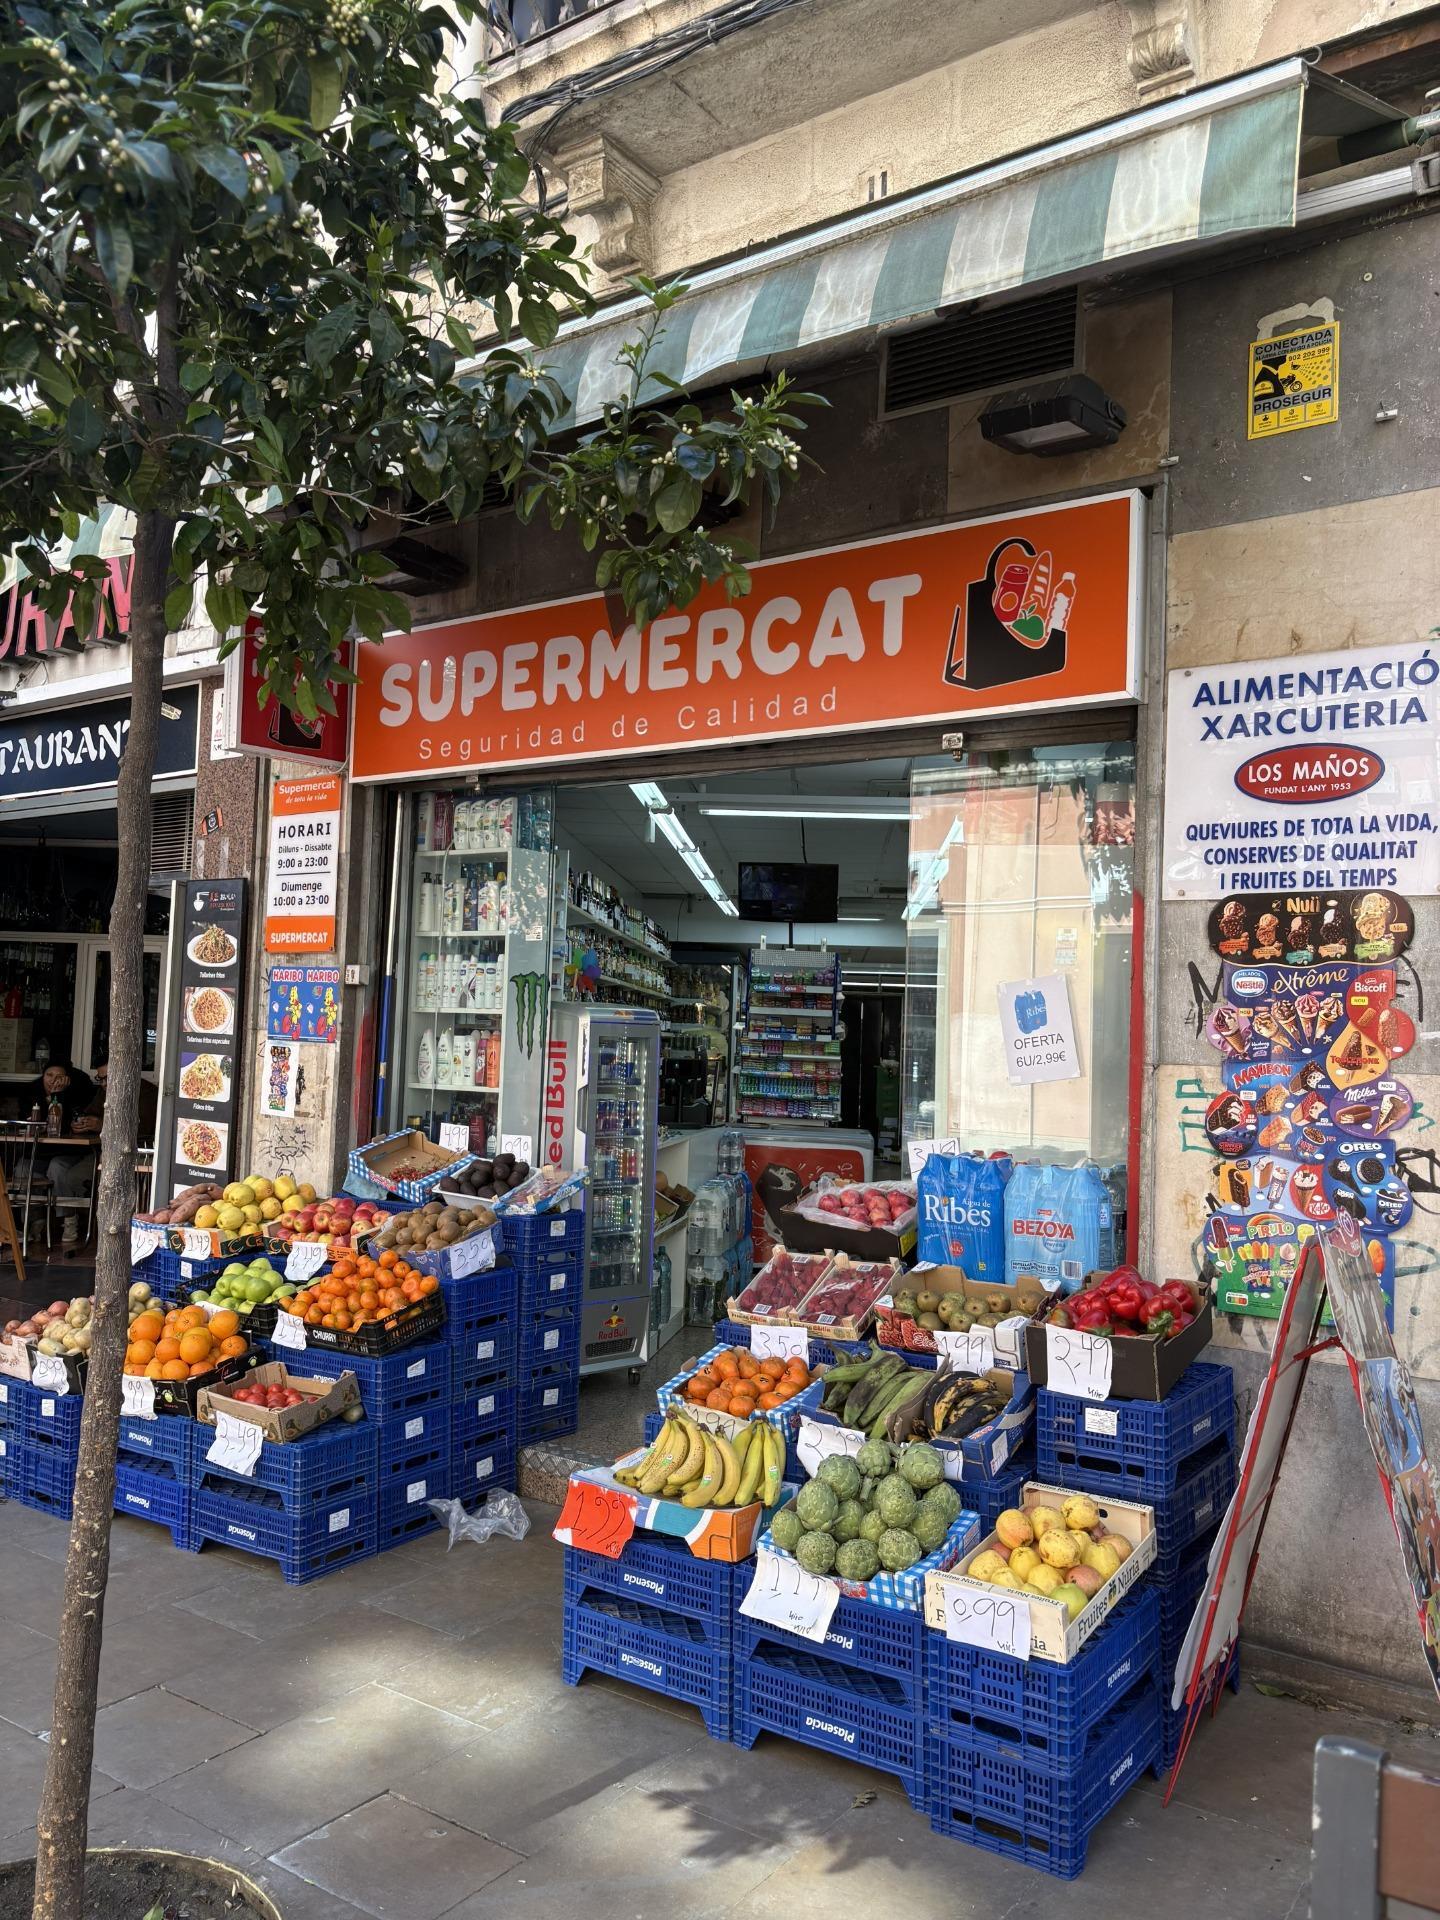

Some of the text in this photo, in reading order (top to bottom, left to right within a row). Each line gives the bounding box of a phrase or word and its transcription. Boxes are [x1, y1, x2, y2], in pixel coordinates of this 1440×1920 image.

[1255, 329, 1332, 356] CONECTADA
[1289, 354, 1301, 362] 902
[1303, 350, 1316, 360] 202
[1317, 346, 1331, 356] 999
[1254, 388, 1332, 414] PROSEGUR
[379, 572, 923, 728] SUPERMERCAT
[1192, 649, 1439, 708] ALIMENTACIÓ
[419, 686, 837, 761] Seguridad de Calidad
[1200, 696, 1428, 741] XARCUTERIA
[0, 719, 131, 775] TAURAN
[1247, 753, 1370, 784] LOS MAÑOS
[279, 779, 337, 795] Supermercat
[1264, 782, 1352, 795] FUNDAT L'ANY 1953
[278, 822, 332, 839] HORARI
[1186, 812, 1439, 842] QUEVIURES DE TOTA LA VIDA,
[278, 843, 332, 854] Dilluns Dissabte
[1203, 840, 1418, 866] CONSERVES DE QUALITAT
[277, 859, 296, 869] 9:00
[304, 856, 328, 867] 23:00
[281, 881, 322, 893] Diumenge
[1219, 867, 1398, 890] I FRUITES DEL TEMPS
[273, 896, 296, 906] 10:00
[270, 932, 328, 943] SUPERMERCAT
[272, 969, 340, 983] HARIBO HARIBO
[1354, 981, 1387, 993] Biscoff
[1014, 1033, 1065, 1050] OFERTA
[1016, 1051, 1067, 1068] 6U/2,99€
[1232, 1062, 1292, 1090] MAXIBON
[545, 1040, 567, 1168] ed Bull
[1343, 1087, 1378, 1102] Milka
[1340, 1142, 1382, 1154] OREO
[924, 1194, 991, 1227] Ribes
[962, 1198, 991, 1208] Aigua de
[1379, 1200, 1403, 1208] OREO
[1012, 1219, 1075, 1240] BEZOYA
[614, 1328, 628, 1338] Bull
[1054, 1335, 1109, 1384] 2,49
[228, 1524, 256, 1541] Plasencia
[623, 1573, 665, 1595] Plasencia
[934, 1571, 960, 1582] Fruites
[1077, 1559, 1141, 1642] Fruites Núria
[953, 1597, 1015, 1647] 0,99
[825, 1629, 854, 1651] Plase
[621, 1652, 663, 1677] Plasencia
[805, 1715, 856, 1745] Plasencia
